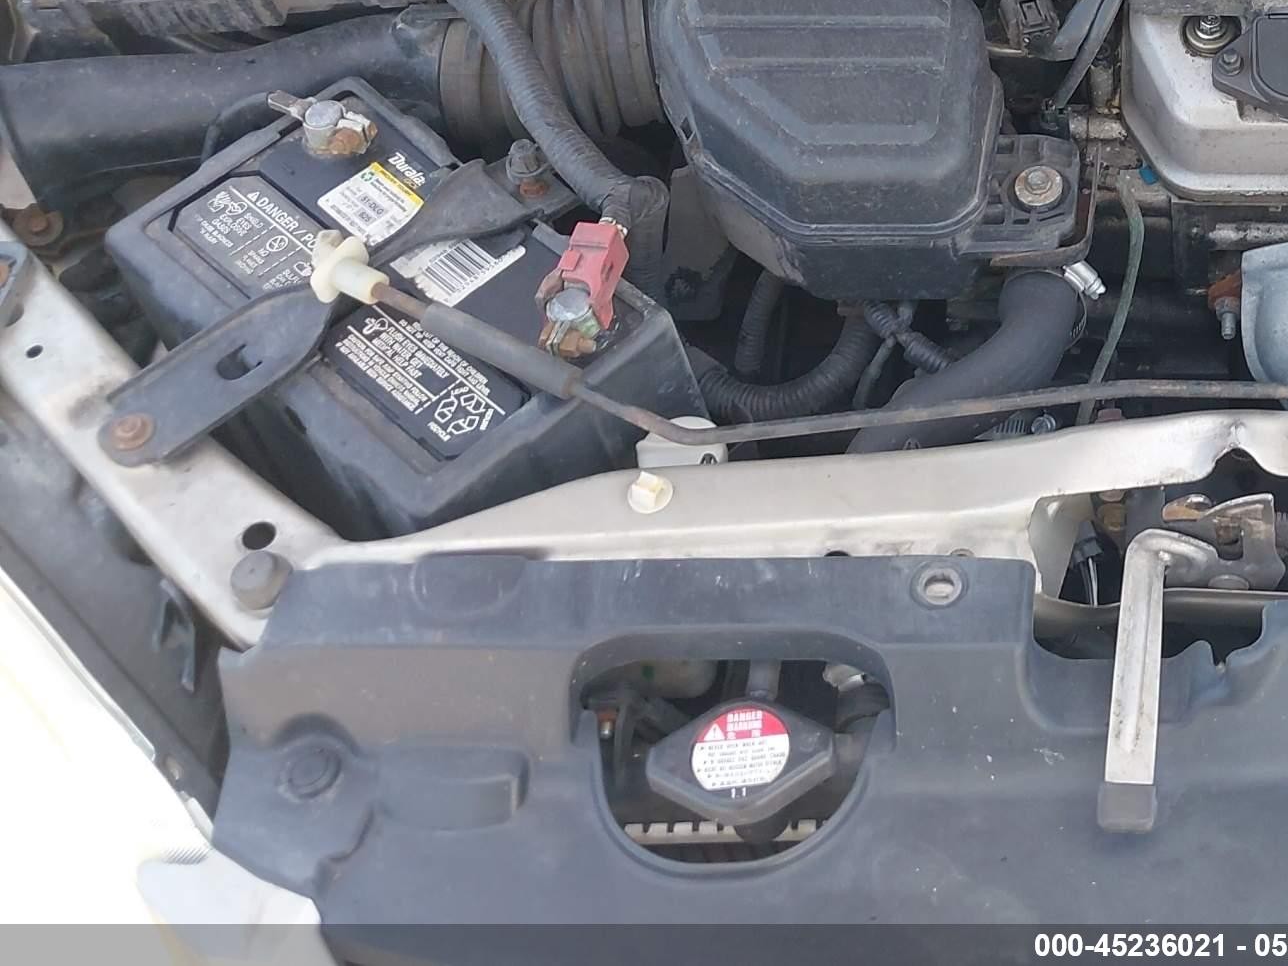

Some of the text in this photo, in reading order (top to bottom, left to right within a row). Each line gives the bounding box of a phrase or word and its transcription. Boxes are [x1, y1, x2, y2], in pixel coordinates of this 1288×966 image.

[256, 197, 298, 230] DANGER
[387, 327, 404, 341] FLUSH
[402, 339, 417, 351] EYES
[392, 355, 407, 366] HELP
[404, 365, 421, 378] FAST
